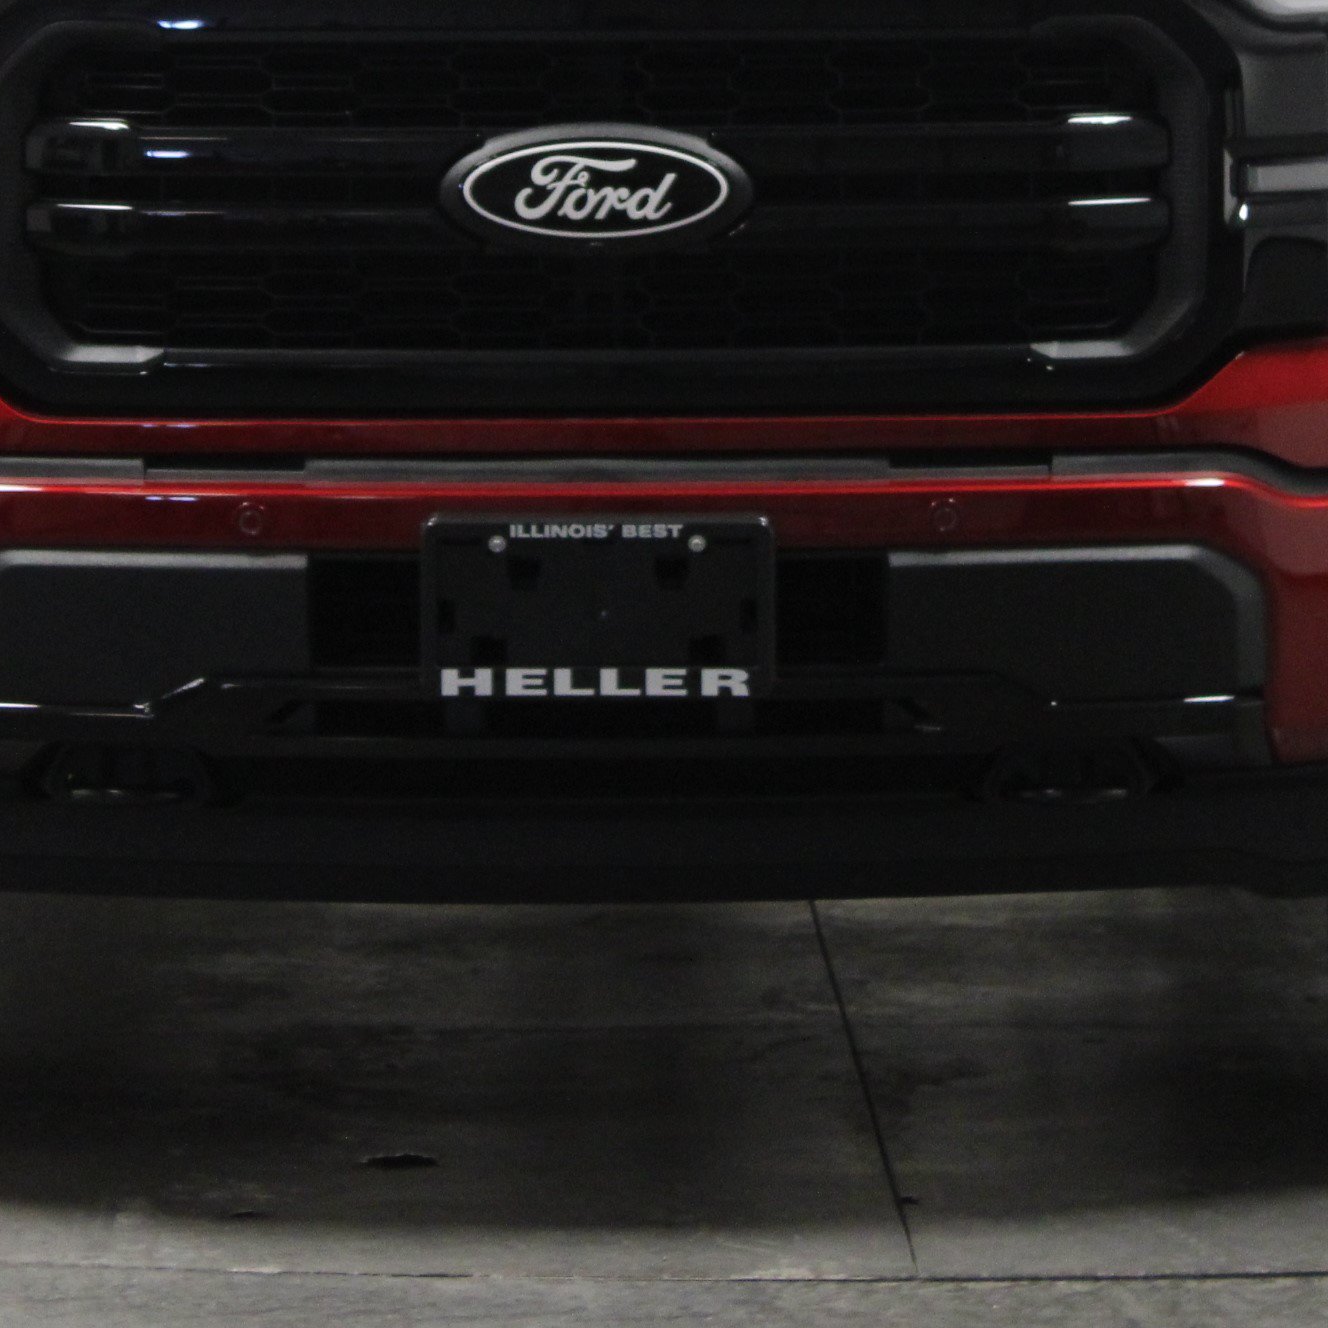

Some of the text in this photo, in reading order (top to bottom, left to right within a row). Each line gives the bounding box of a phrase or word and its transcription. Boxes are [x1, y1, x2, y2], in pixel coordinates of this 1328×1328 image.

[514, 155, 674, 221] Ford
[621, 523, 684, 539] BEST
[440, 667, 750, 697] HELLER
